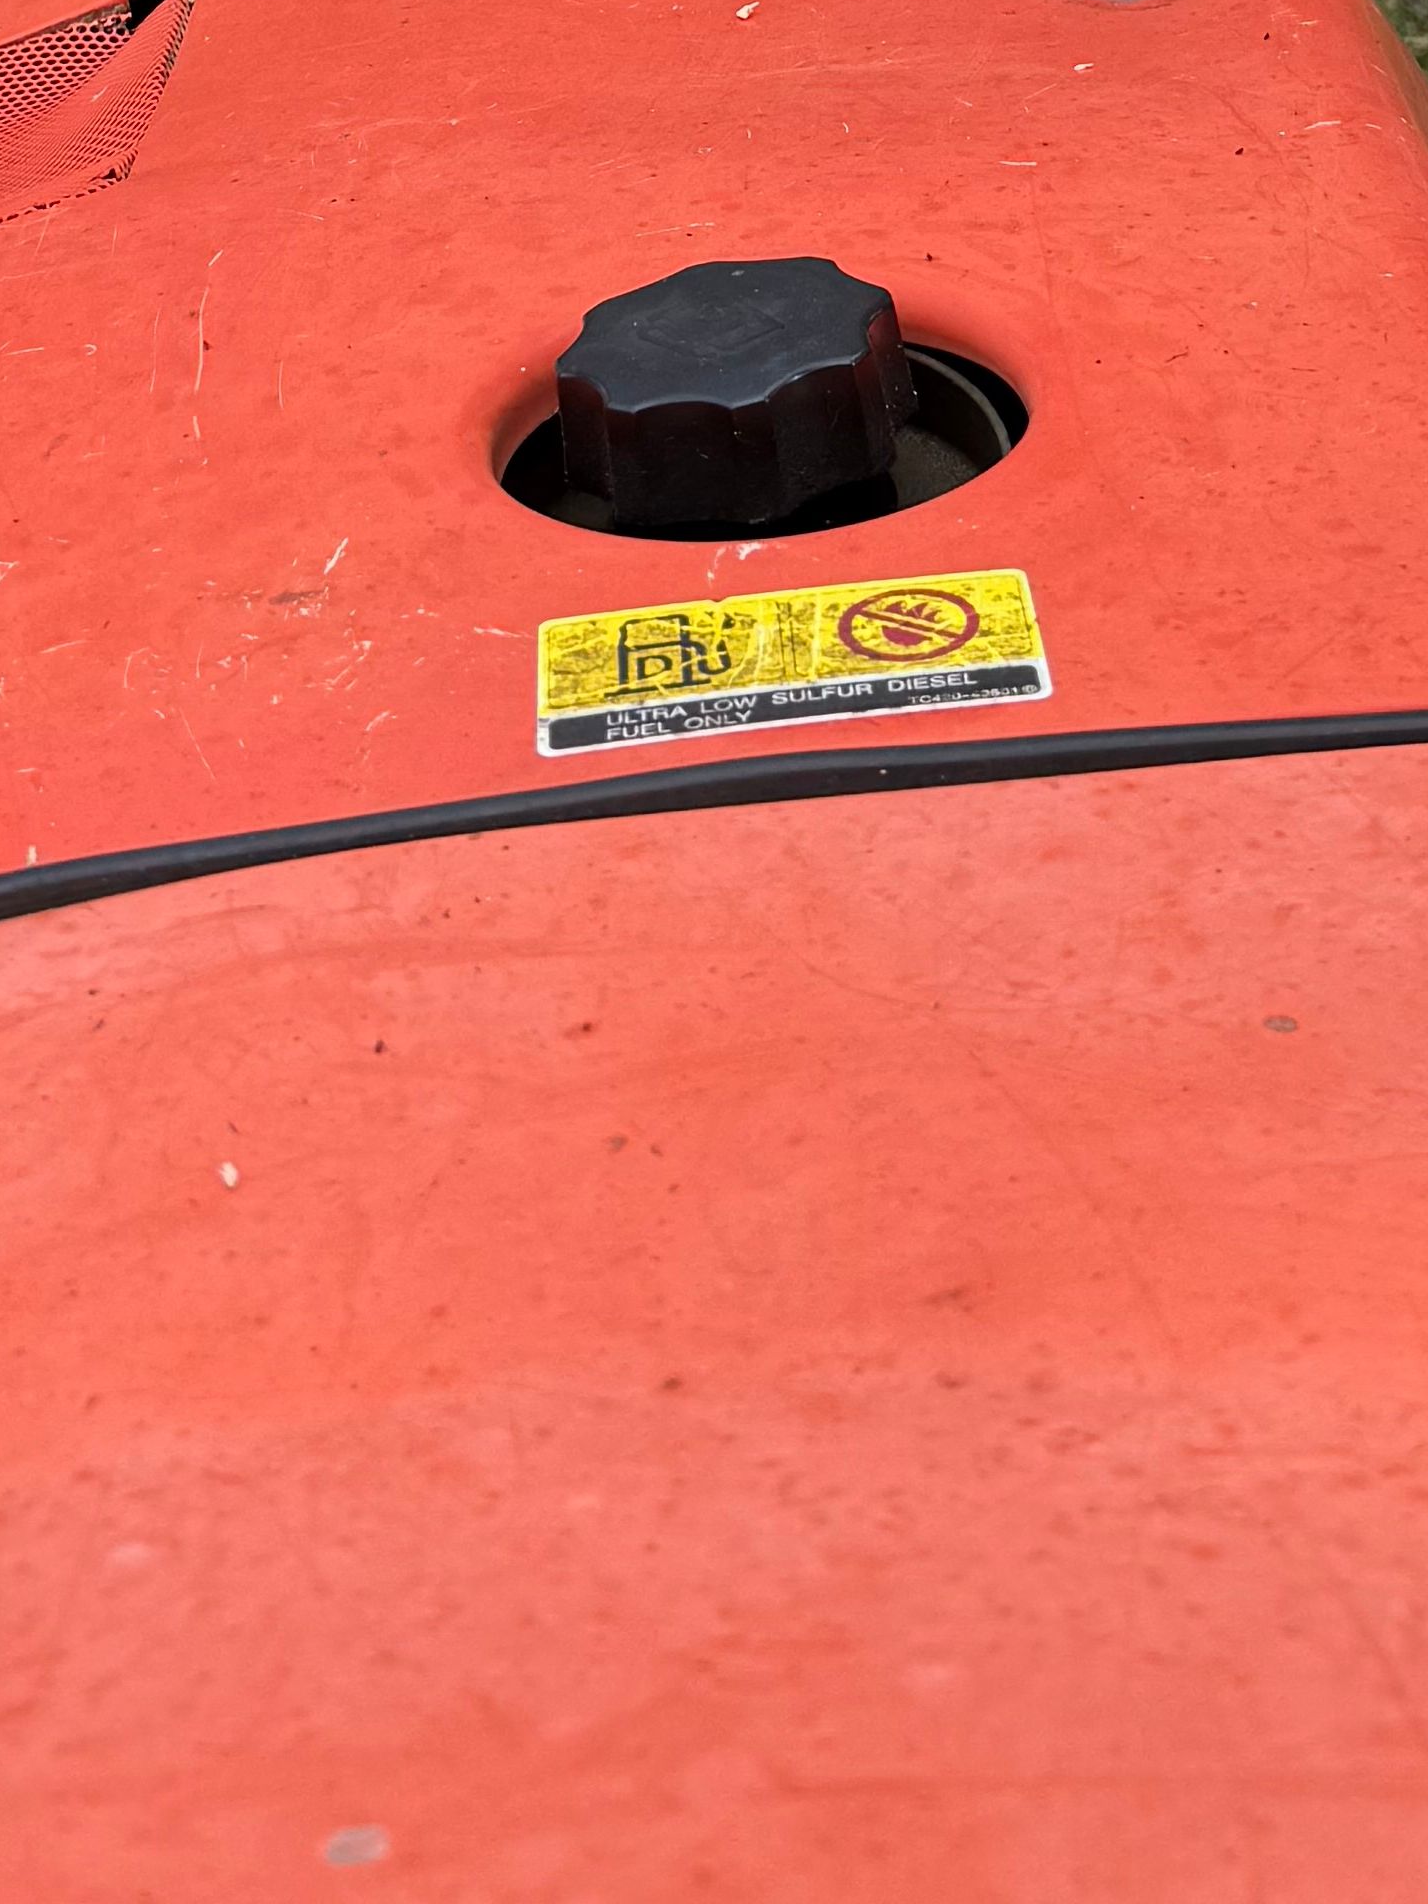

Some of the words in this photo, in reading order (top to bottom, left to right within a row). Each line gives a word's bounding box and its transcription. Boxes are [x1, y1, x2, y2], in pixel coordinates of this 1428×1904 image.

[605, 704, 688, 727] ULTRA
[700, 695, 758, 715] LOW
[771, 682, 873, 706] SULFUR
[887, 671, 978, 693] DIESEL
[605, 721, 671, 741] FUEL
[683, 709, 754, 730] ONLY
